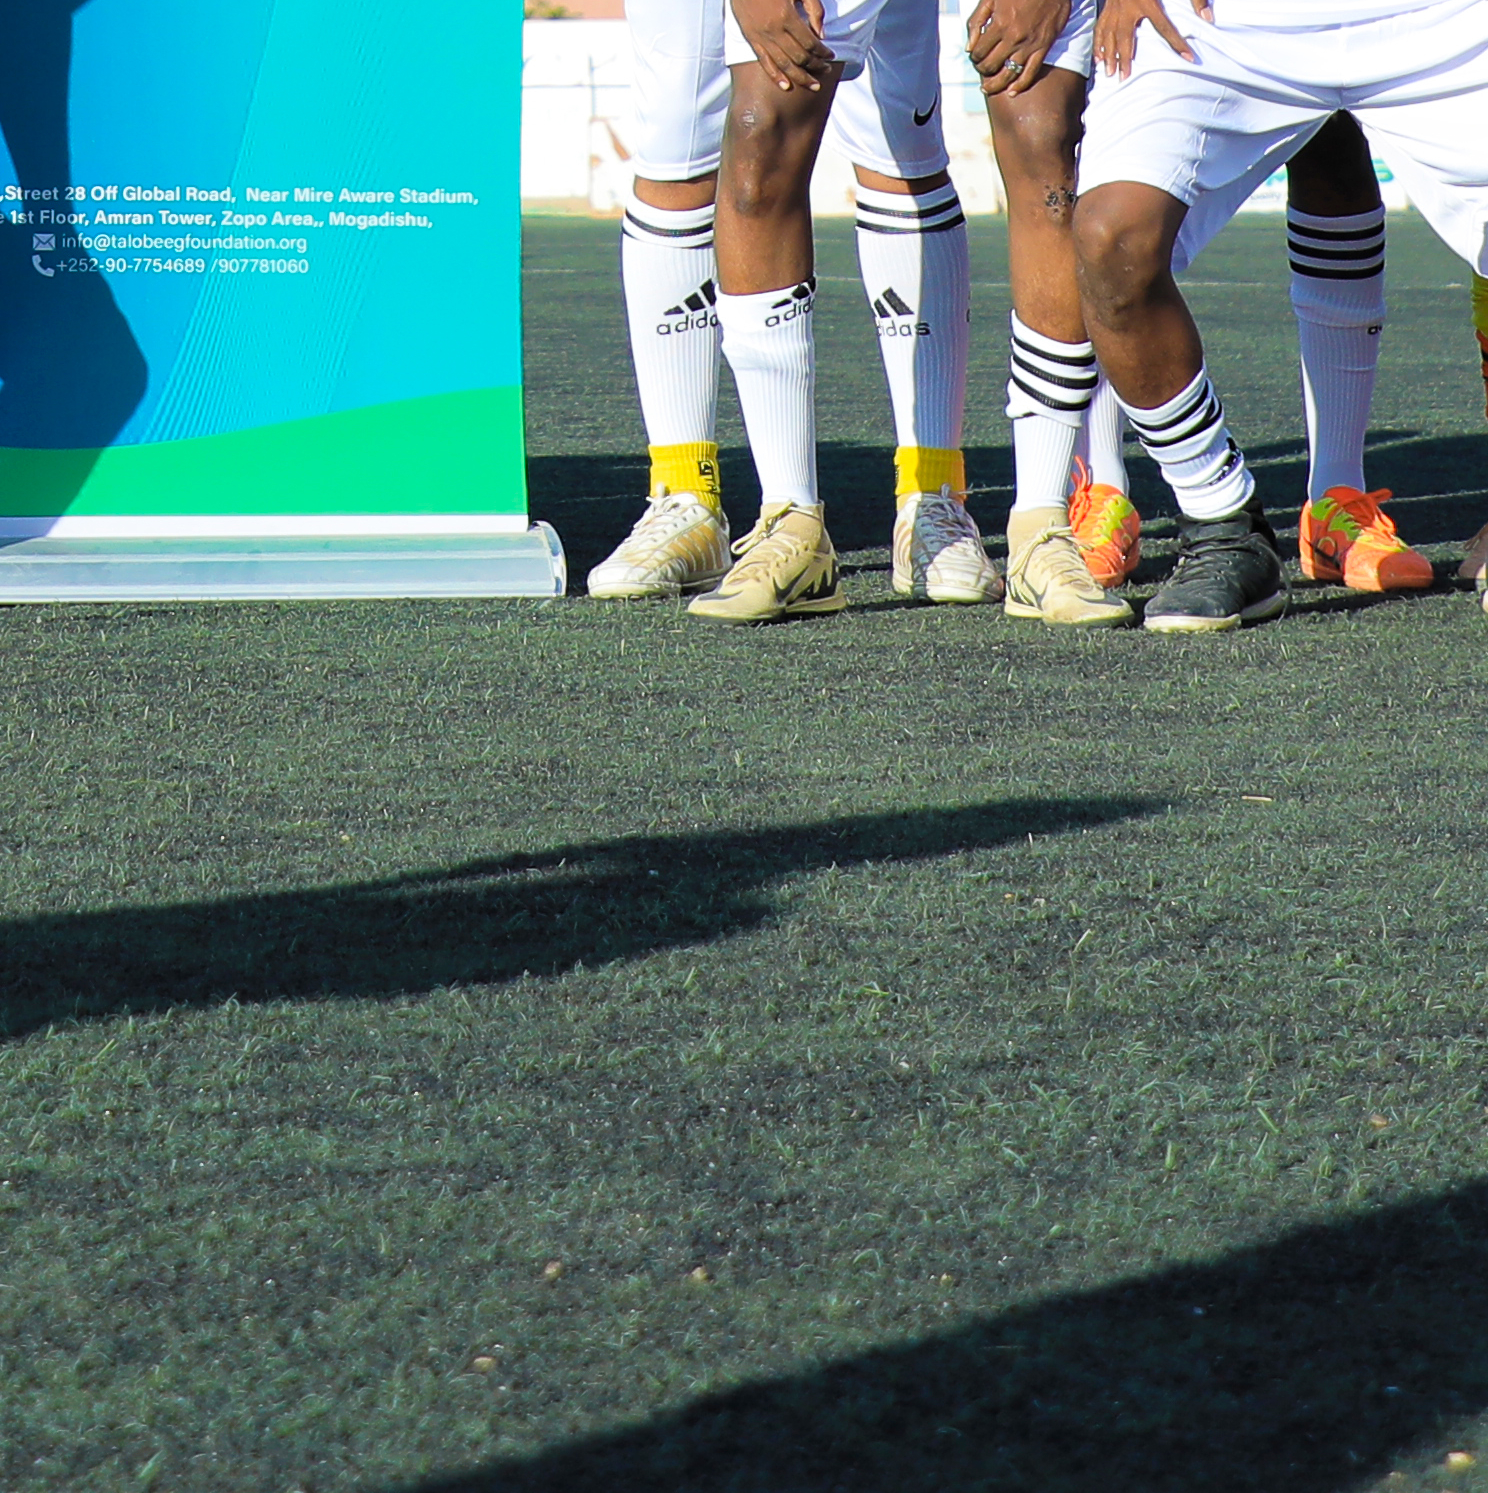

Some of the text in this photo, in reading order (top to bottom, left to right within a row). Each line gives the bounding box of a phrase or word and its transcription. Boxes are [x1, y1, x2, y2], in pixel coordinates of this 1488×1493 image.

[64, 186, 86, 201] 28
[90, 185, 118, 201] Off
[122, 185, 181, 202] Global
[186, 186, 237, 205] Road,
[246, 187, 289, 202] Near
[294, 187, 334, 203] Mire
[338, 188, 395, 204] Aware
[399, 188, 479, 206] Stadium,
[9, 209, 34, 225] 1st
[40, 209, 90, 227] Floor,
[94, 210, 154, 225] Amran
[159, 210, 217, 228] Tower,
[221, 211, 267, 229] Zopo
[272, 211, 325, 228] Area,,
[328, 211, 433, 230] Mogadishu,
[62, 233, 308, 254] info@talobeegfoundation.org
[56, 258, 309, 274] +252-90-7754689 /907781060
